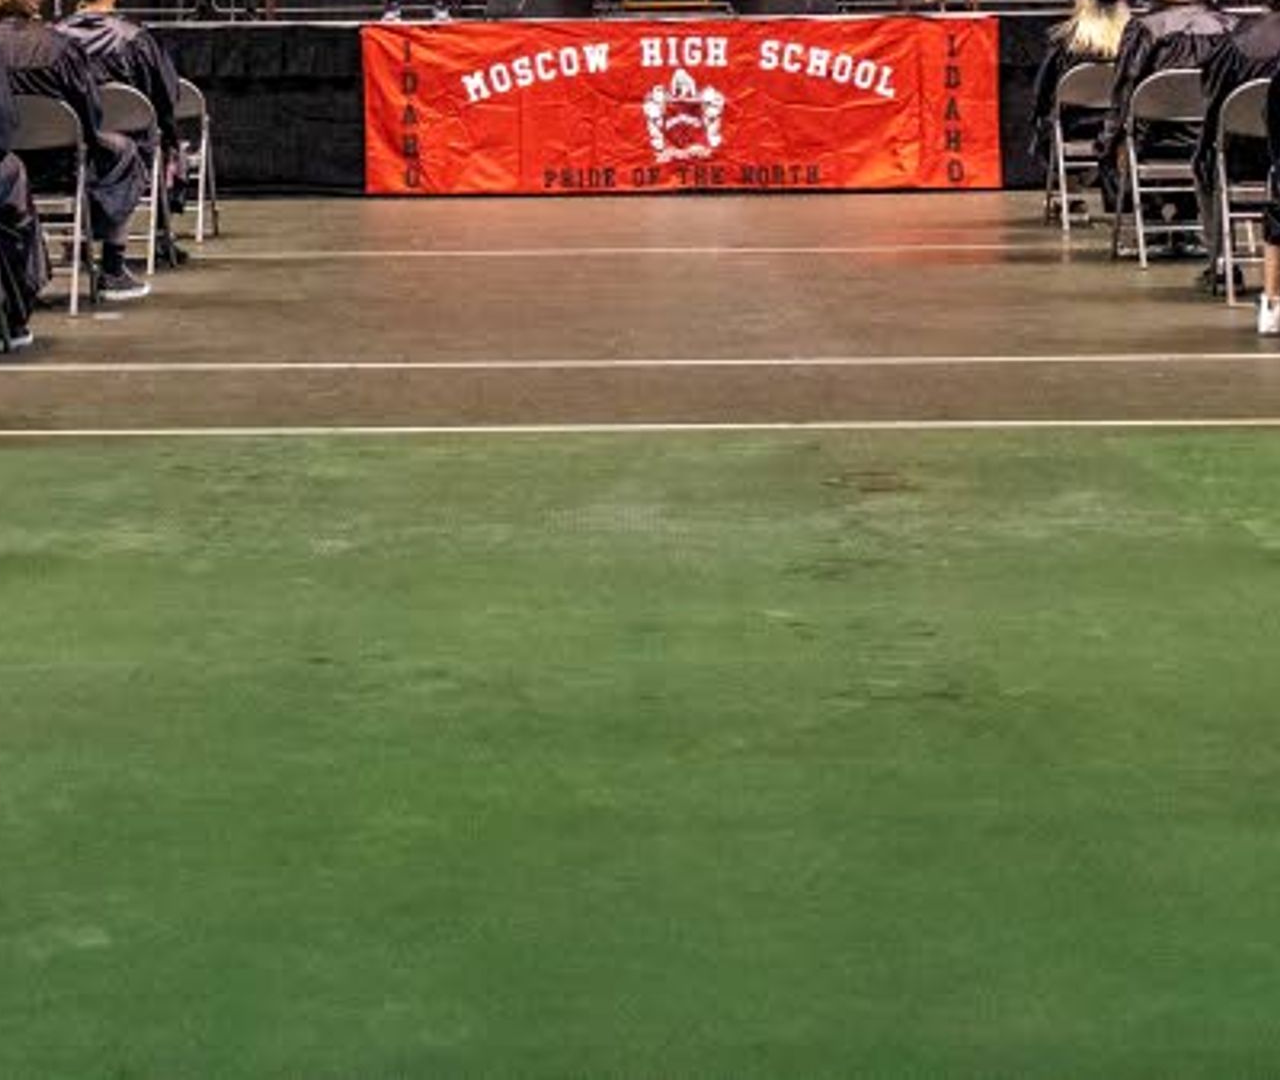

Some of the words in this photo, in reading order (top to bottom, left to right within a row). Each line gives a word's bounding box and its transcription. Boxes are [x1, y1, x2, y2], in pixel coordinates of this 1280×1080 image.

[400, 39, 420, 188] IDAHO
[460, 42, 610, 103] MOSCOW
[640, 36, 729, 67] HIGH
[758, 39, 896, 98] SCHOOL
[943, 33, 964, 183] IDAHO
[542, 168, 616, 189] PRIDE
[632, 167, 662, 187] OF
[677, 166, 726, 186] THE
[740, 164, 820, 186] NORTH
